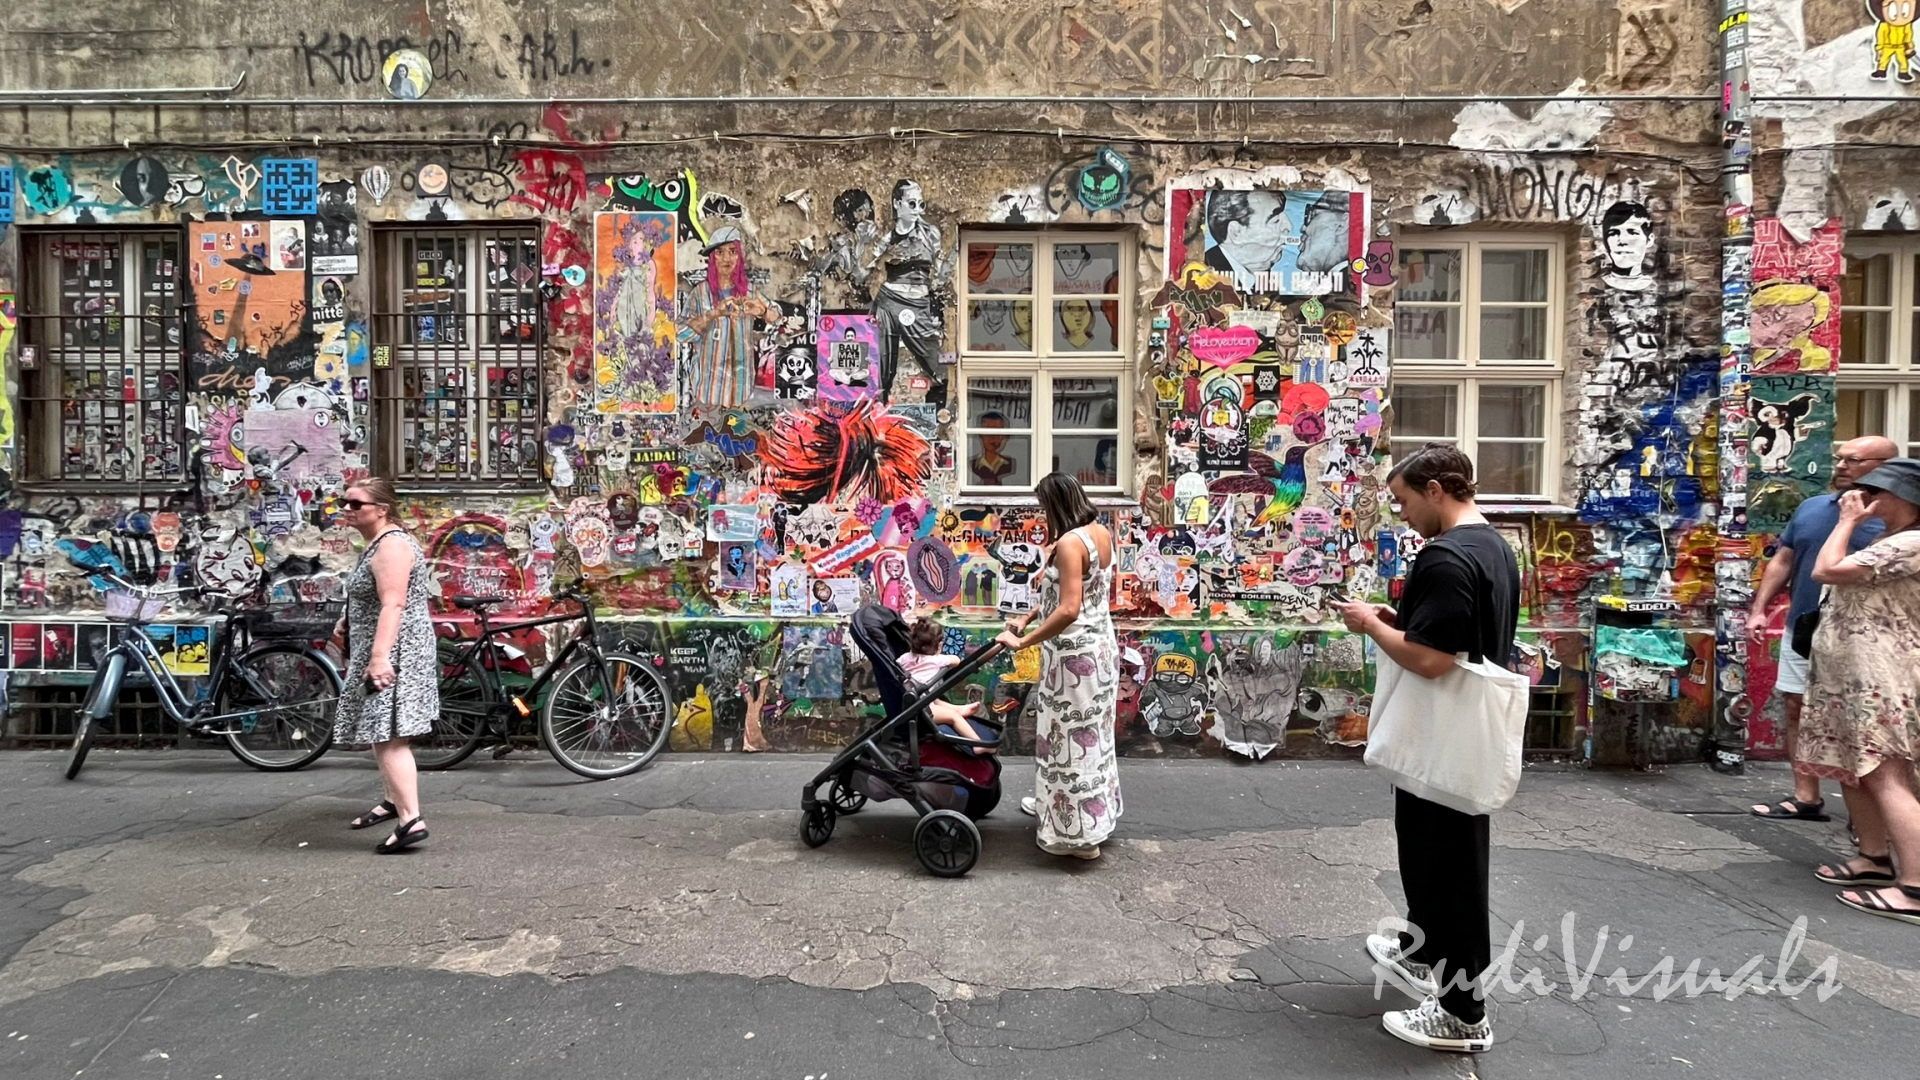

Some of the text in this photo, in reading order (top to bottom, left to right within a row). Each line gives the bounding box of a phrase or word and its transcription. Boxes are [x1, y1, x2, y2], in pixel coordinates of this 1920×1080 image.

[838, 344, 859, 353] BAU
[838, 360, 860, 368] EIN.
[1328, 405, 1342, 418] Hug
[1342, 415, 1356, 424] You
[634, 451, 676, 462] JA!DA!
[835, 543, 860, 560] Regeln
